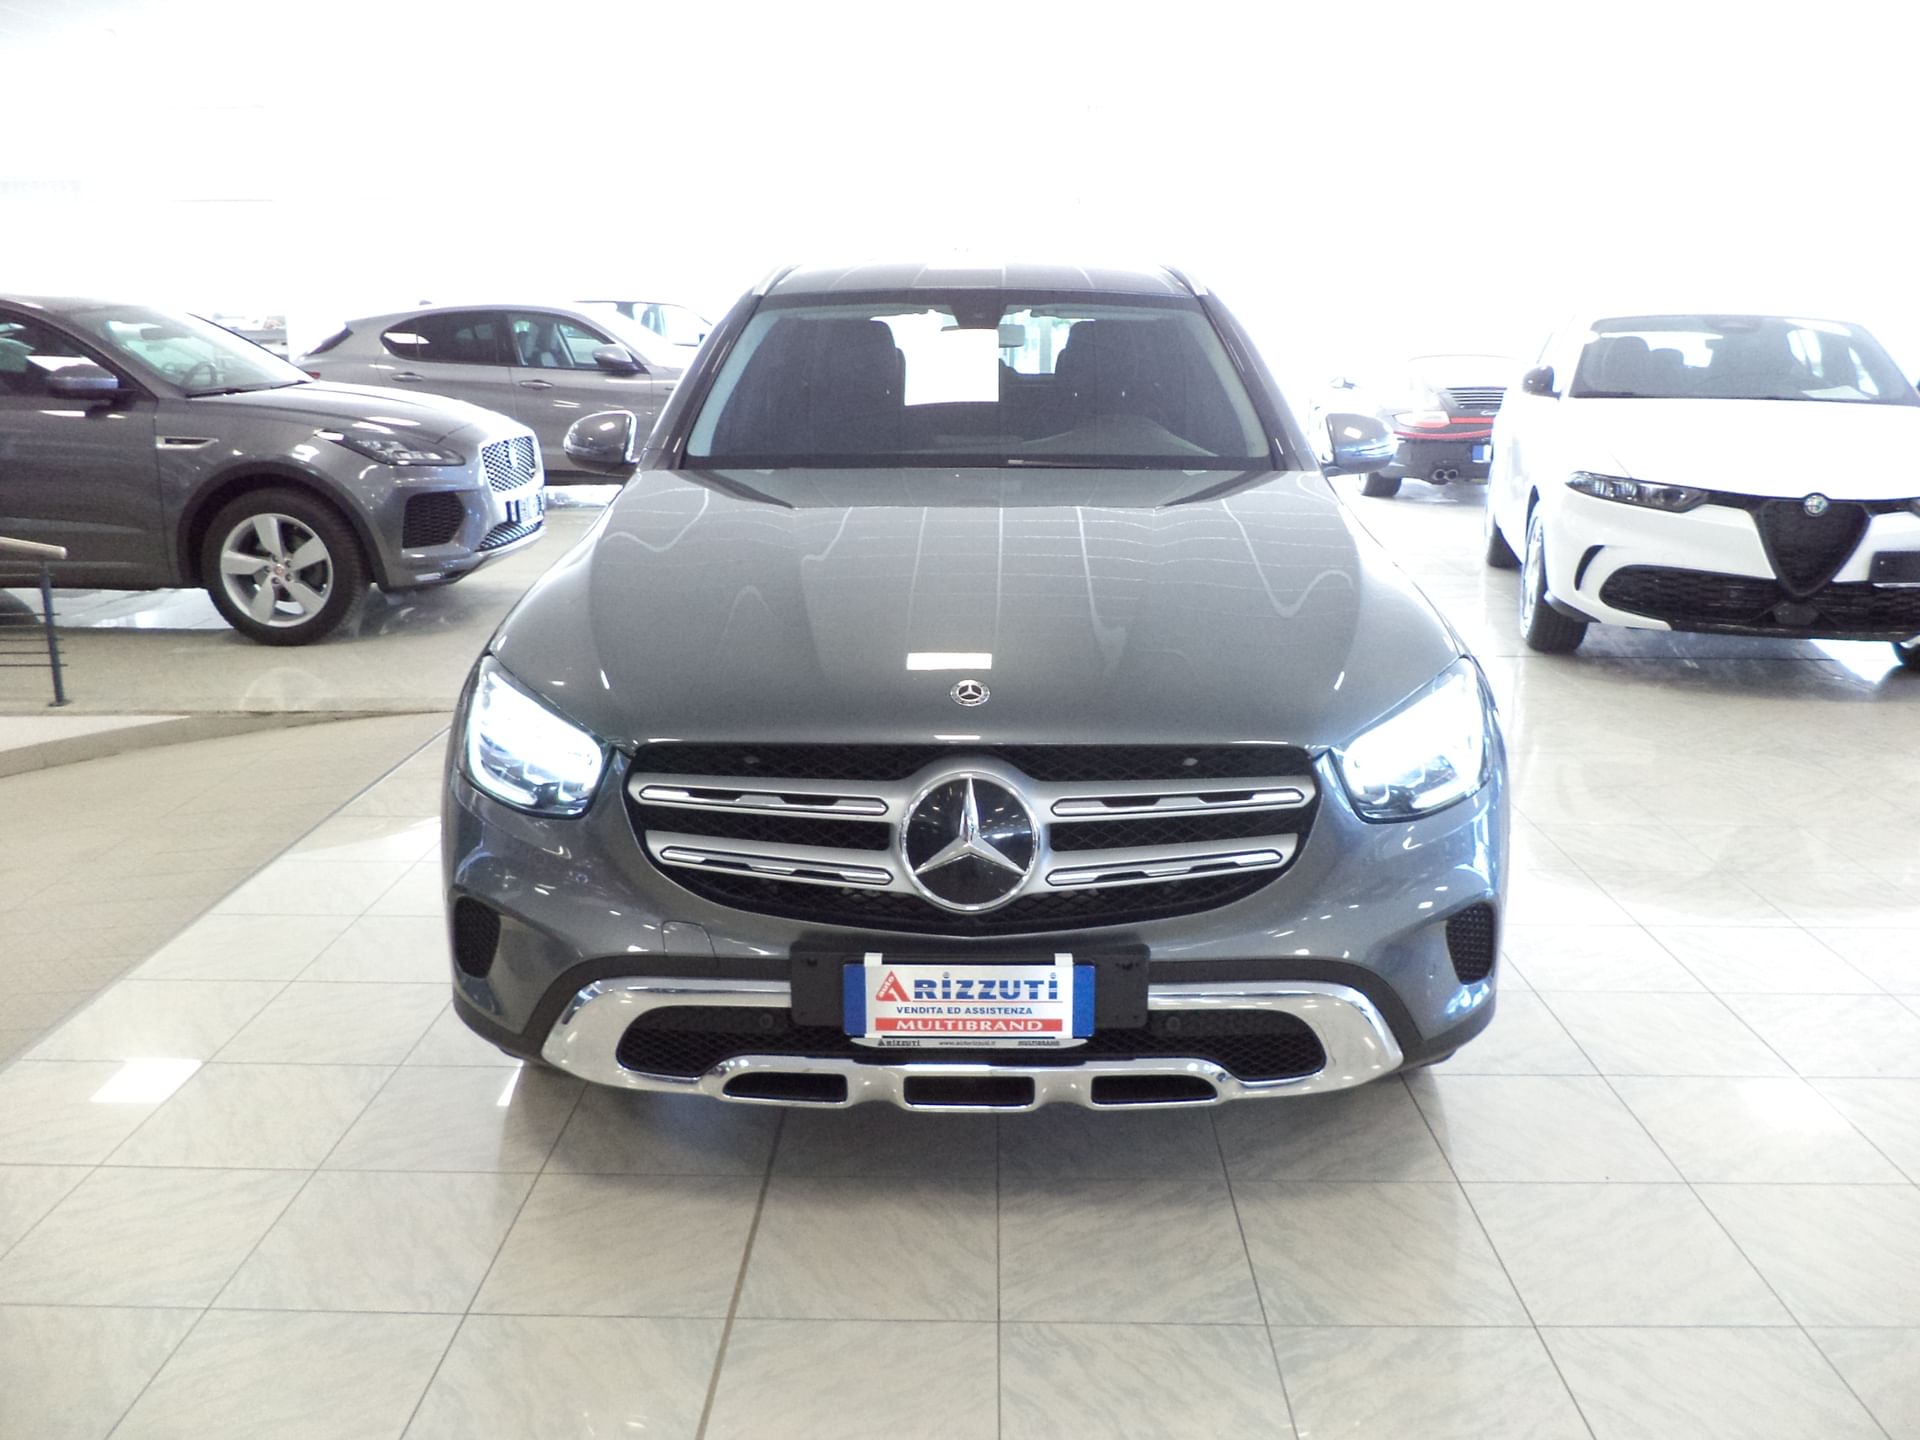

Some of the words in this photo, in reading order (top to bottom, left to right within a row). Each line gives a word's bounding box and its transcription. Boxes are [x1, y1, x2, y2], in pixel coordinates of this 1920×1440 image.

[896, 1006, 944, 1015] VENDITA
[947, 1007, 961, 1015] ED
[965, 1007, 1033, 1015] ASSISTENZA
[896, 1020, 1043, 1031] MULTIBRAND
